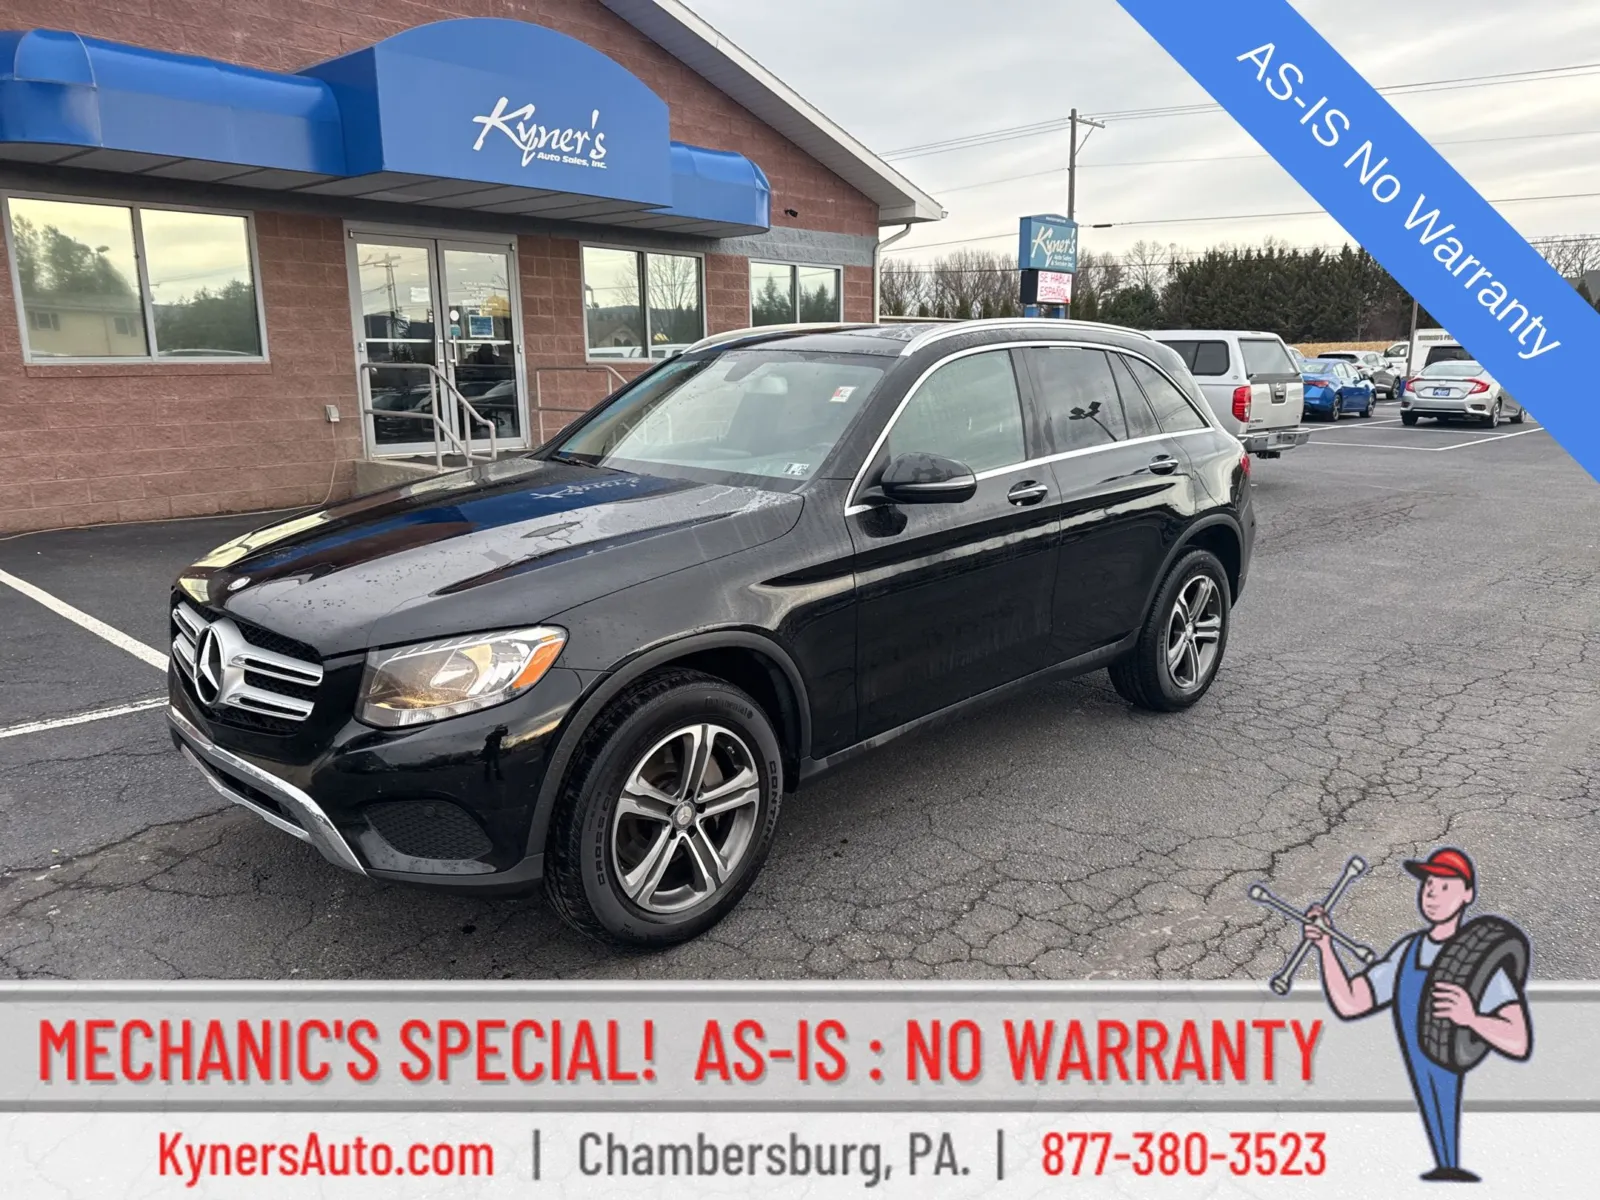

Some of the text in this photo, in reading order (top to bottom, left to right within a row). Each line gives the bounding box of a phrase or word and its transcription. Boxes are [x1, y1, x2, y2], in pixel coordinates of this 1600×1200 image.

[472, 96, 607, 167] Kyner's
[537, 151, 561, 162] Auto
[562, 155, 589, 167] Sales,
[1031, 225, 1076, 268] Kyner's
[1040, 273, 1070, 284] SE HABLA
[1040, 286, 1067, 298] ESPAÑOL
